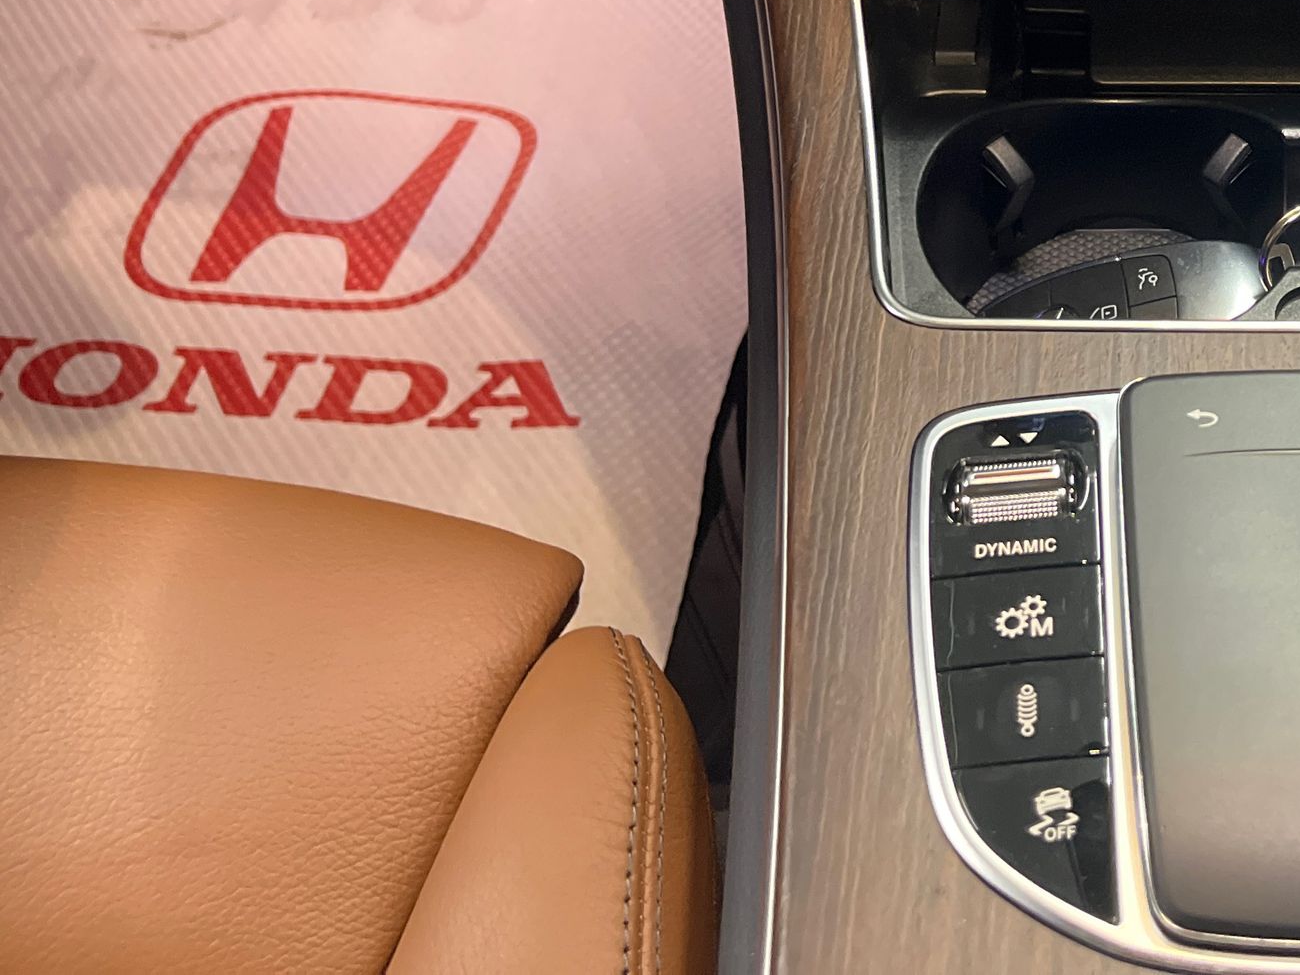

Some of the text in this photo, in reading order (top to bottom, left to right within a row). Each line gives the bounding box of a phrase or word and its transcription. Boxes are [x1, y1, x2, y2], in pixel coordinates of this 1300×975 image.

[974, 537, 1057, 559] DYNAMIC
[1030, 617, 1053, 637] M
[1043, 823, 1077, 842] OFF
